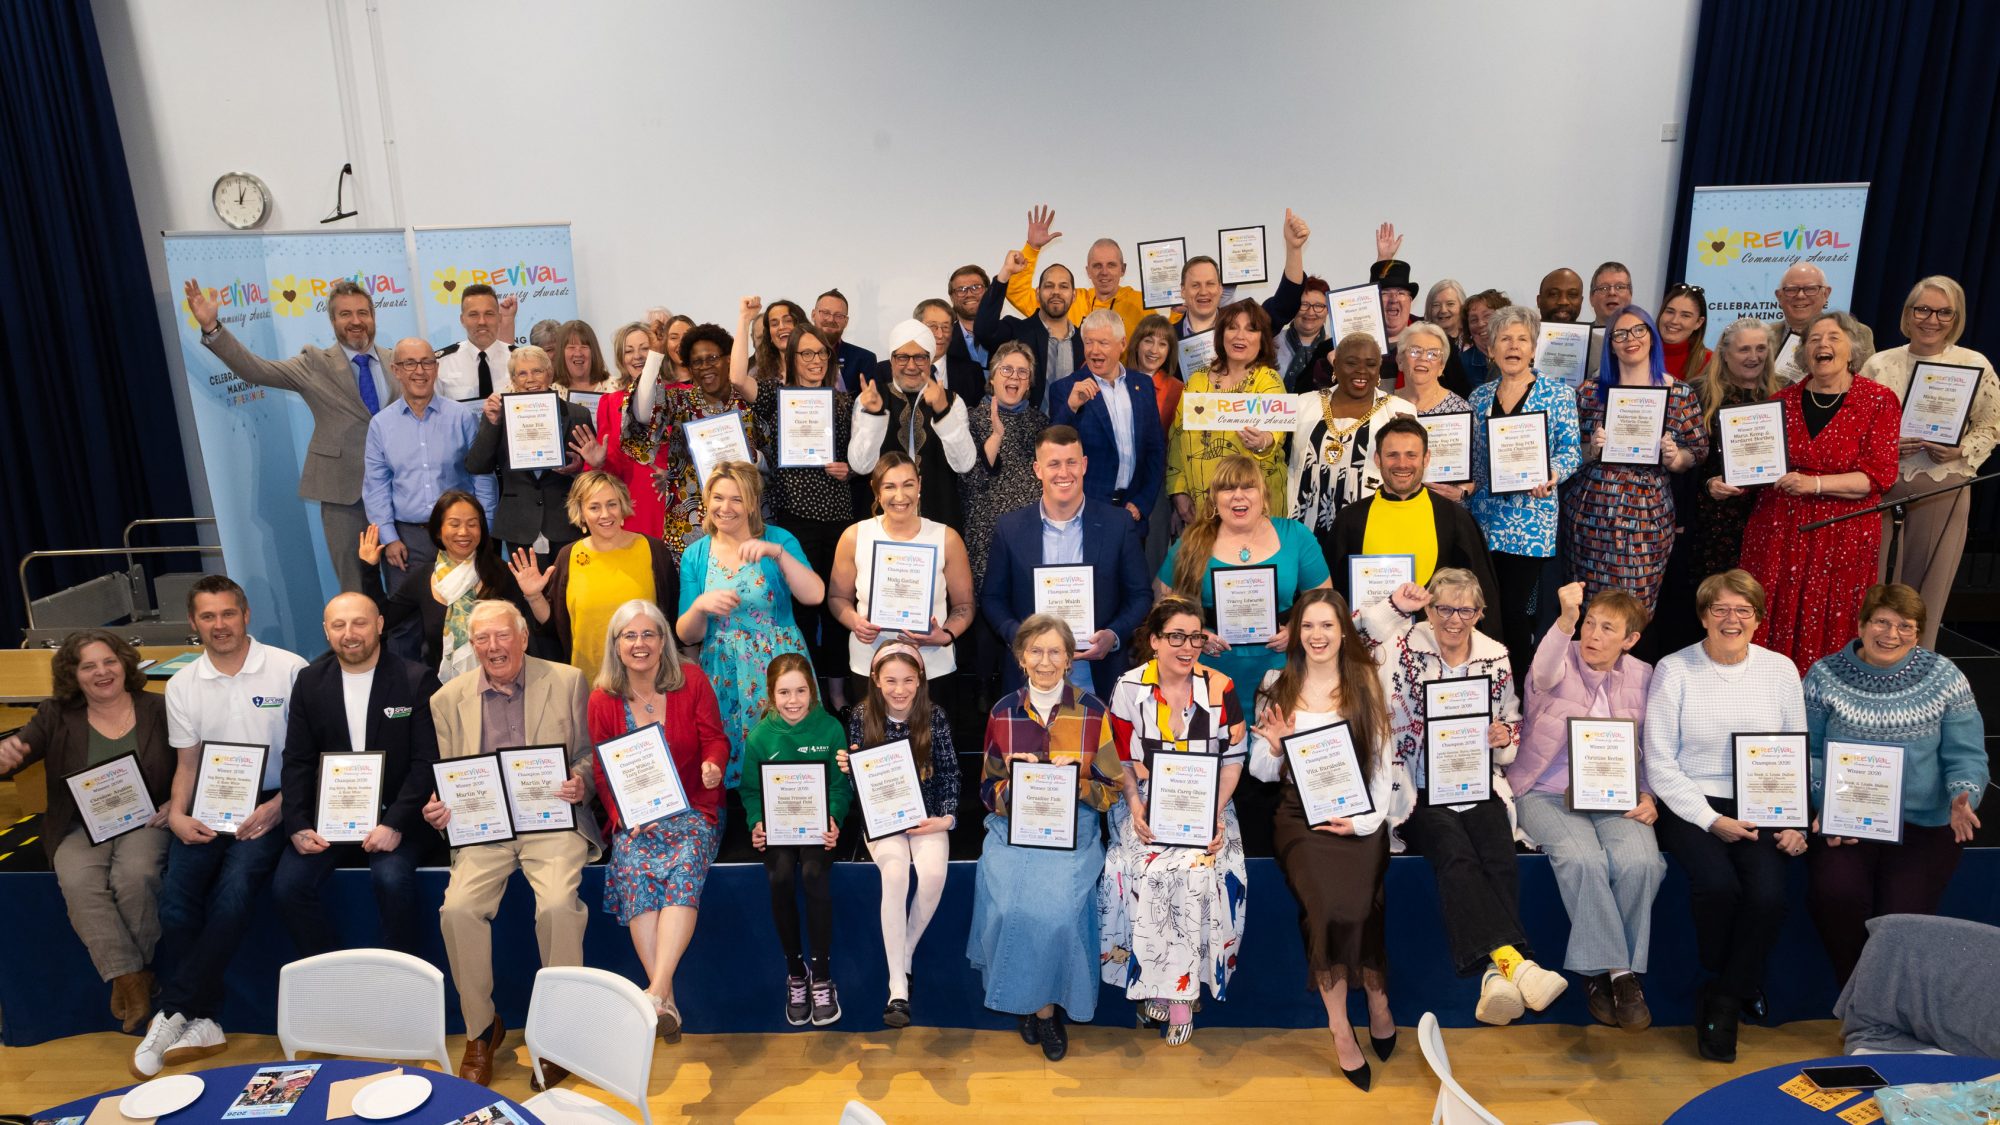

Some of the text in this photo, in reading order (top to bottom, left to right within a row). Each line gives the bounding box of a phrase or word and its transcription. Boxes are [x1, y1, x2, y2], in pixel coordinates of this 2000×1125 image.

[1742, 251, 1849, 267] Community Awards
[533, 286, 569, 298] Awards
[374, 297, 408, 308] Awards
[1218, 415, 1296, 428] Community Awards
